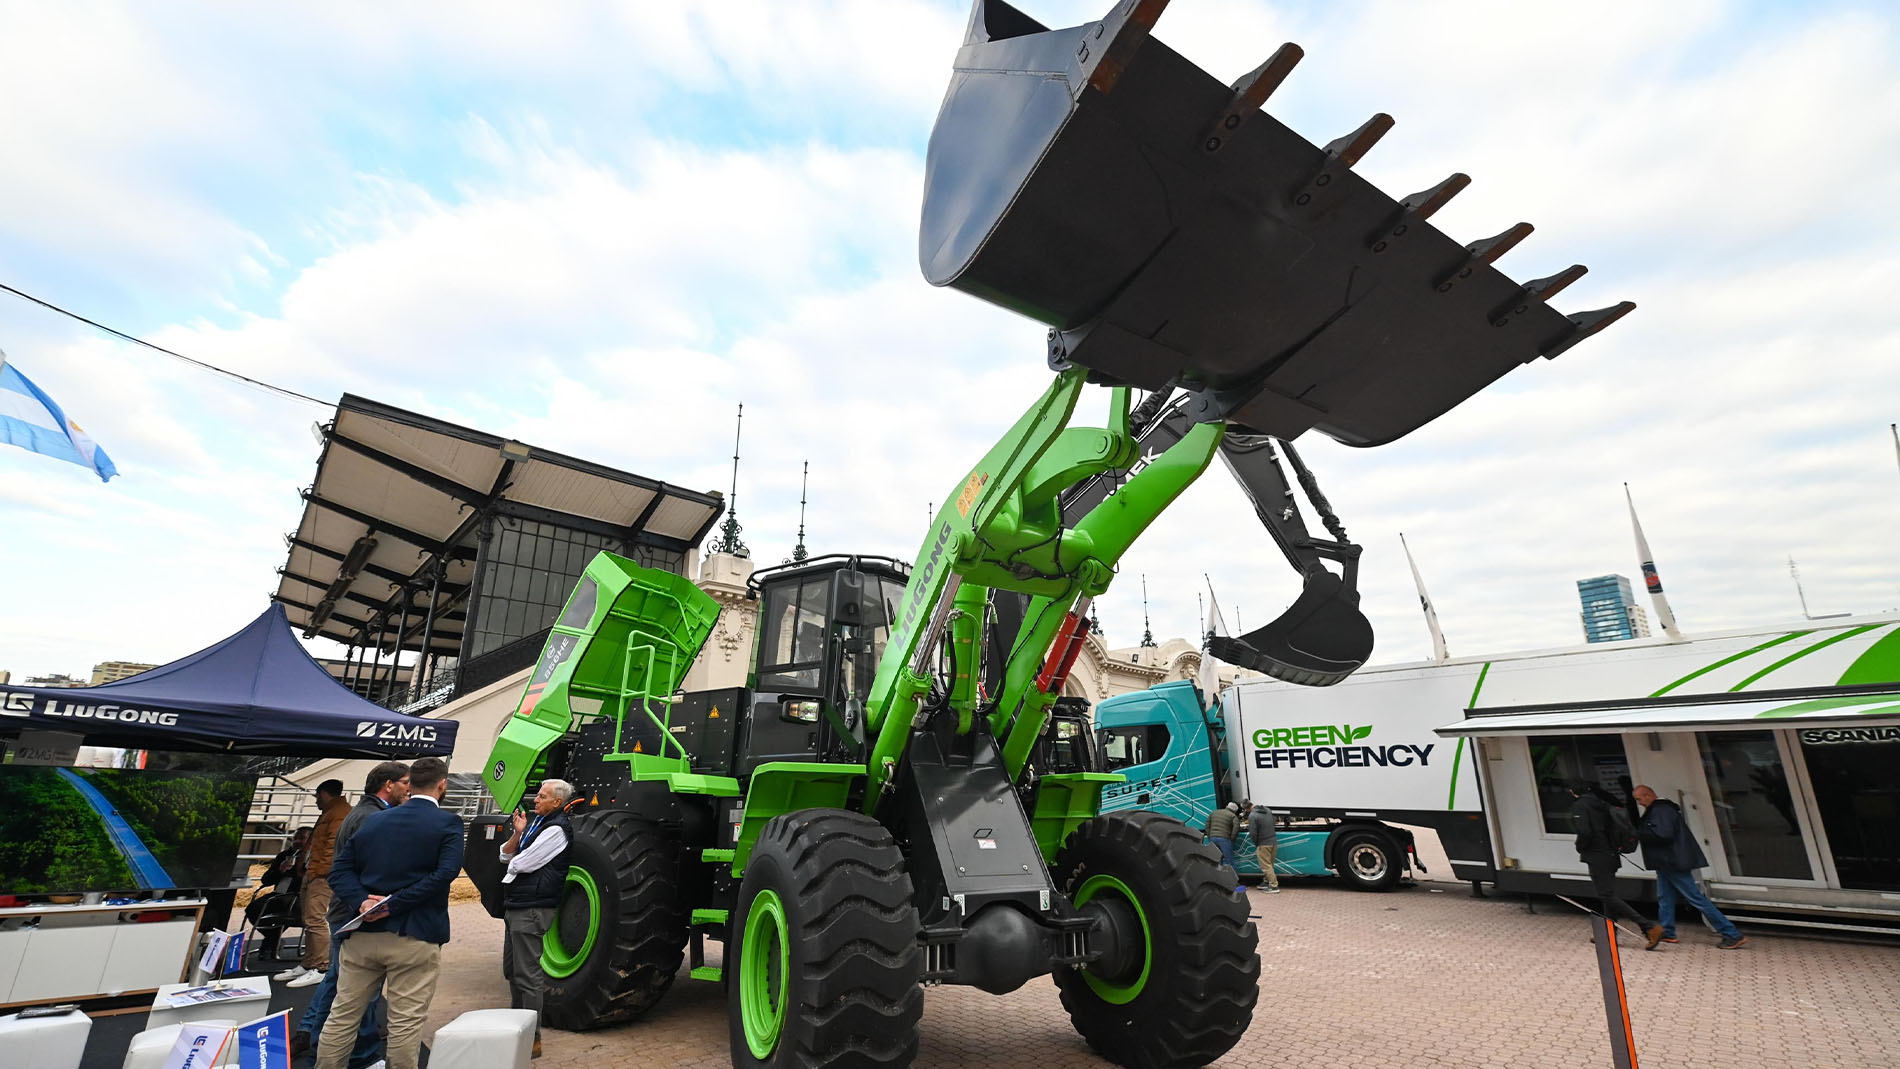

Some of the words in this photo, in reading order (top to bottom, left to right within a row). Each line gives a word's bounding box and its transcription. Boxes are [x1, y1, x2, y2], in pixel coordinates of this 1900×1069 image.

[379, 723, 437, 741] ZMG
[1252, 724, 1353, 748] GREEN
[1802, 727, 1900, 744] SCANIA
[1254, 744, 1435, 769] EFFICIENCY
[1107, 774, 1177, 798] SUPER
